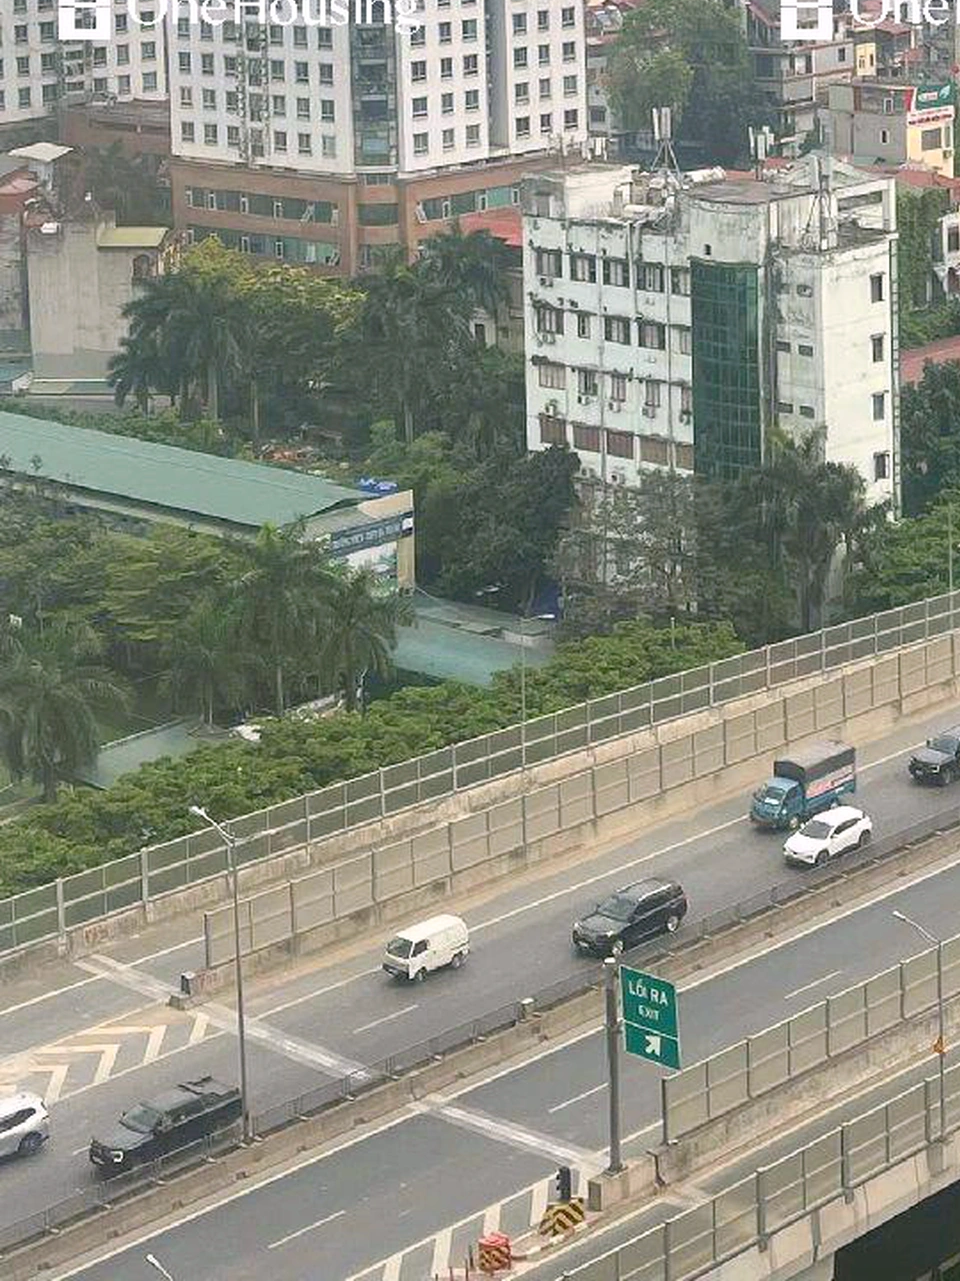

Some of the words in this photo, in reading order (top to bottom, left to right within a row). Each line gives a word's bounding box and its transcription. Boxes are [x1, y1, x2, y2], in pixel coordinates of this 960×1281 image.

[628, 978, 648, 999] LỐI
[650, 989, 668, 1007] RA
[638, 1005, 659, 1021] EXIT
